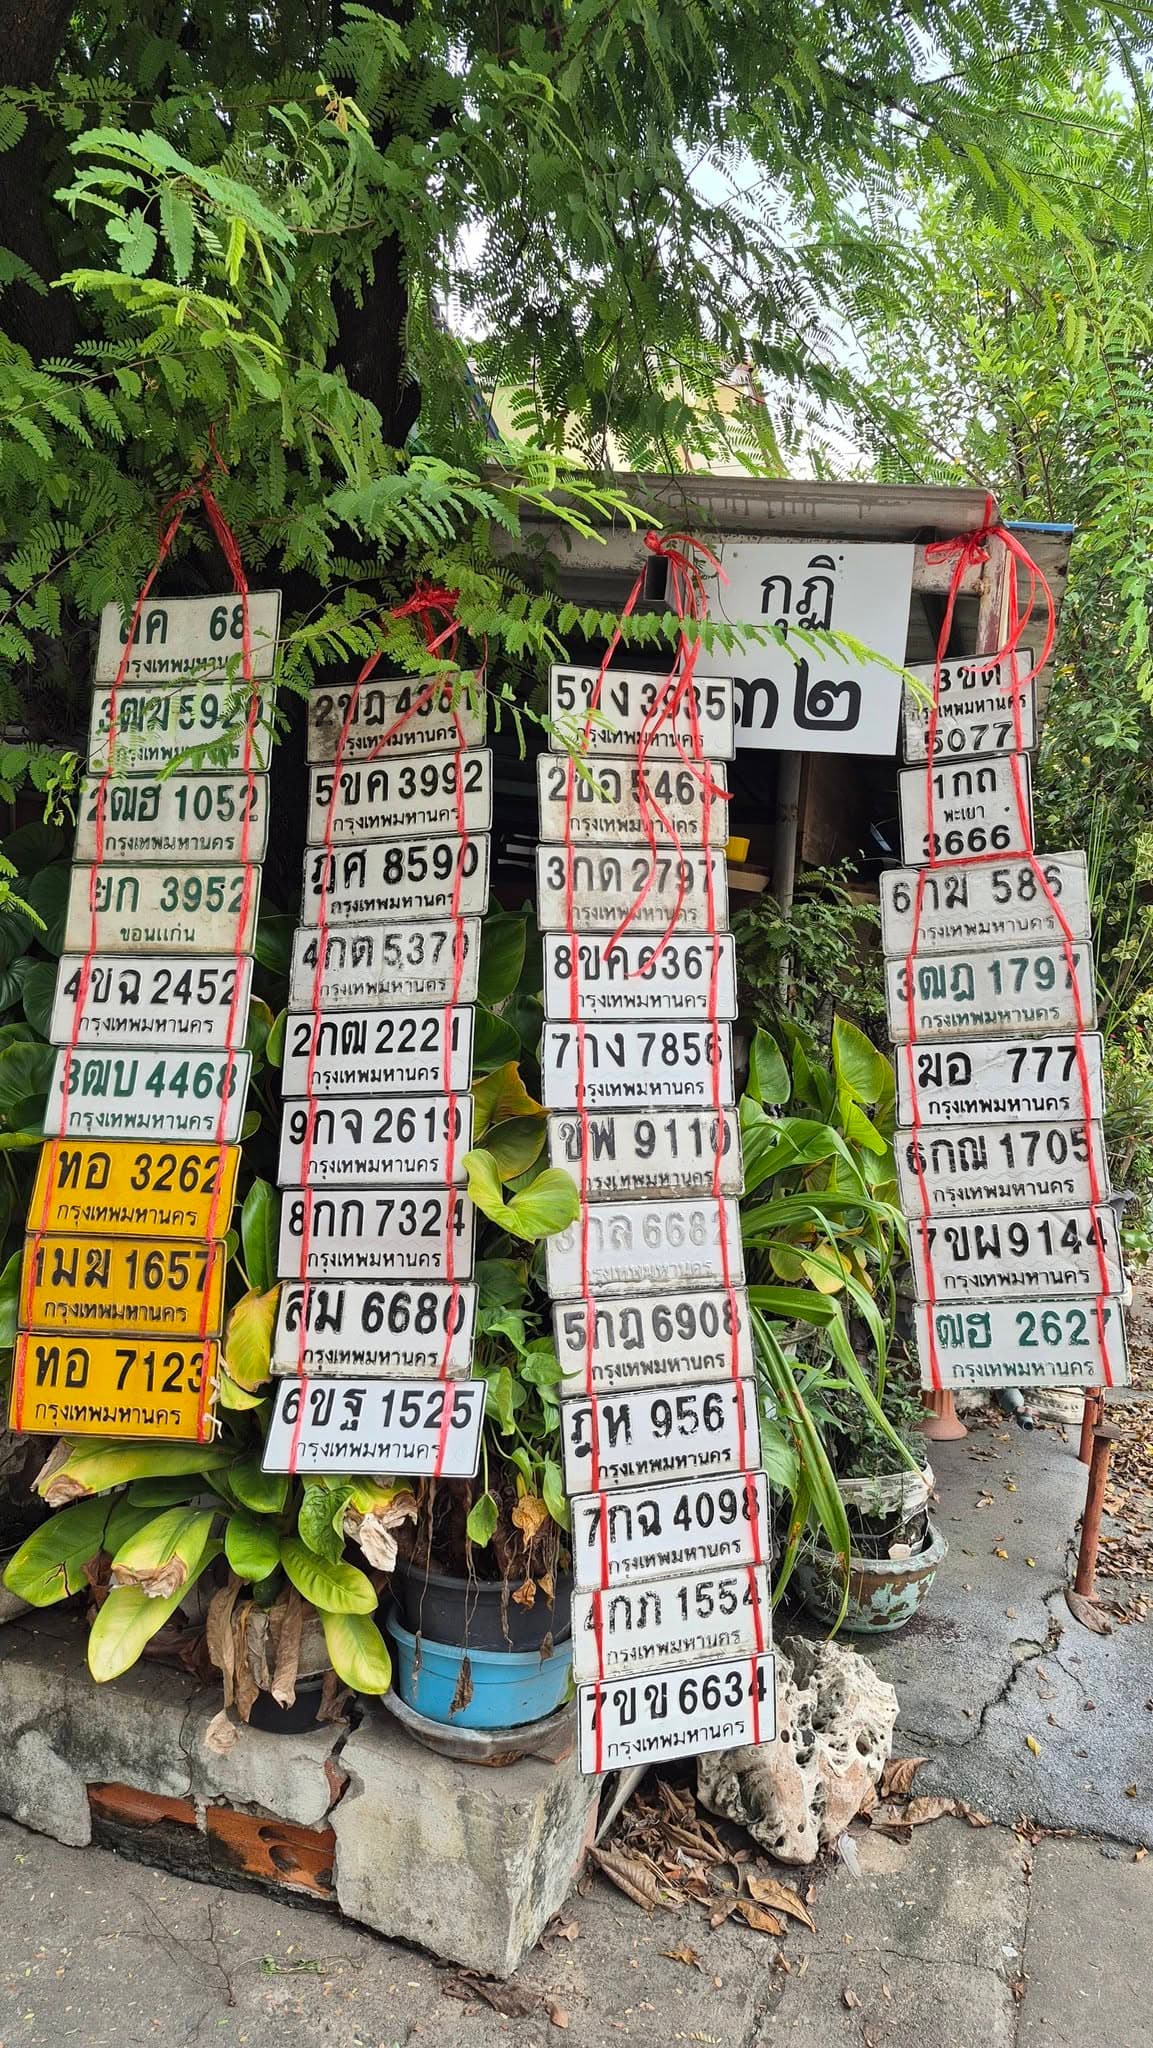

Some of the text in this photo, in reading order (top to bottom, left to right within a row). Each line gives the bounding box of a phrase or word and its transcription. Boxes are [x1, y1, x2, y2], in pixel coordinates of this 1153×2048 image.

[760, 554, 836, 641] กุฏิ
[210, 604, 248, 641] 68
[120, 655, 229, 678] กรุงเทพมหาน
[557, 675, 726, 721] 5ขง 3935
[734, 658, 861, 731] ๓๒
[911, 694, 1026, 725] กรุเทพมหานคร
[924, 721, 1013, 754] 5077
[316, 760, 483, 807] 5ขค 3992
[548, 767, 621, 804] 2ขอ
[933, 768, 997, 799] 1กถ
[87, 784, 259, 822] 2ฒฮ 1052
[333, 807, 460, 835] กรุงเทพมหานคร
[944, 805, 985, 822] พะเยา
[105, 834, 235, 856] กรุงเทพมหานคร
[923, 824, 1010, 857] 3666
[383, 842, 479, 884] 8590
[546, 855, 716, 894] 3กด 2797
[90, 876, 247, 913] ยก 3952
[991, 865, 1063, 904] 586
[331, 893, 455, 918] กรุงเทพมหานคร
[120, 922, 195, 942] ขอนแก่น
[303, 931, 469, 970] 4กต 5370
[554, 944, 724, 981] 8ขค 6367
[987, 953, 1081, 995] 1797
[63, 967, 240, 1006] 4ขฉ 2452
[320, 979, 447, 1001] กรุงเทพมหานคร
[77, 1016, 214, 1037] กรุงเทพมหานคร
[292, 1017, 460, 1057] 2กฒ 2221
[920, 1006, 1060, 1034] กรุงเทพมหานคร
[552, 1031, 723, 1068] 7กง 7856
[918, 1045, 1078, 1088] ฆอ 777
[59, 1058, 238, 1099] 3ฒบ 4468
[311, 1066, 439, 1090] กรุงเทพมหานคร
[575, 1081, 704, 1103] กรุงเทพมหานคร
[69, 1110, 215, 1132] กรุงเทพมหานคร
[289, 1106, 462, 1145] 9กจ 2619
[929, 1096, 1070, 1119] กรุงเทพมหานคร
[634, 1117, 731, 1159] 9110
[1000, 1127, 1090, 1168] 1705
[57, 1150, 225, 1193] ทอ 3262
[308, 1157, 439, 1180] กรุงเทพมหานคร
[933, 1179, 1074, 1207] กรุงเทพมหานคร
[57, 1204, 198, 1226] กรุงเทพมหานคร
[288, 1199, 466, 1237] 8กก 7324
[642, 1211, 732, 1248] 6682
[1008, 1217, 1108, 1257] 9144
[34, 1247, 217, 1292] 1มฆ 1657
[307, 1251, 441, 1273] กรุงเทพมหานคร
[587, 1261, 712, 1286] รุงเทพมหานคร
[943, 1269, 1090, 1293] กรุงเทพมหานคร
[44, 1301, 188, 1325] กรุงเทพมหานคร
[361, 1291, 466, 1335] 6680
[652, 1299, 741, 1342] 6908
[936, 1309, 1112, 1349] ฒฮ 2627
[35, 1345, 207, 1393] ทอ 7123
[302, 1349, 438, 1371] กรุงเทพมหานคร
[592, 1353, 725, 1385] กรุงเทพมหานคร
[952, 1359, 1094, 1382] กรุงเทพมหานคร
[35, 1403, 181, 1426] กรุงเทพมหานคร
[281, 1388, 475, 1431] 6ขฐ 1525
[650, 1392, 747, 1439] 9561
[297, 1440, 441, 1463] กรุงเทพมหานคร
[598, 1448, 731, 1484] กรุงเทพมหานคร
[583, 1486, 760, 1547] 7กฉ 4098
[608, 1539, 741, 1578] กรุงเทพมหานคร
[677, 1576, 762, 1622] 1554
[607, 1629, 741, 1668] กรุงเทพมหานคร
[586, 1666, 767, 1731] 7ขข 6634
[607, 1720, 745, 1759] กรุงเทพมหานคร
